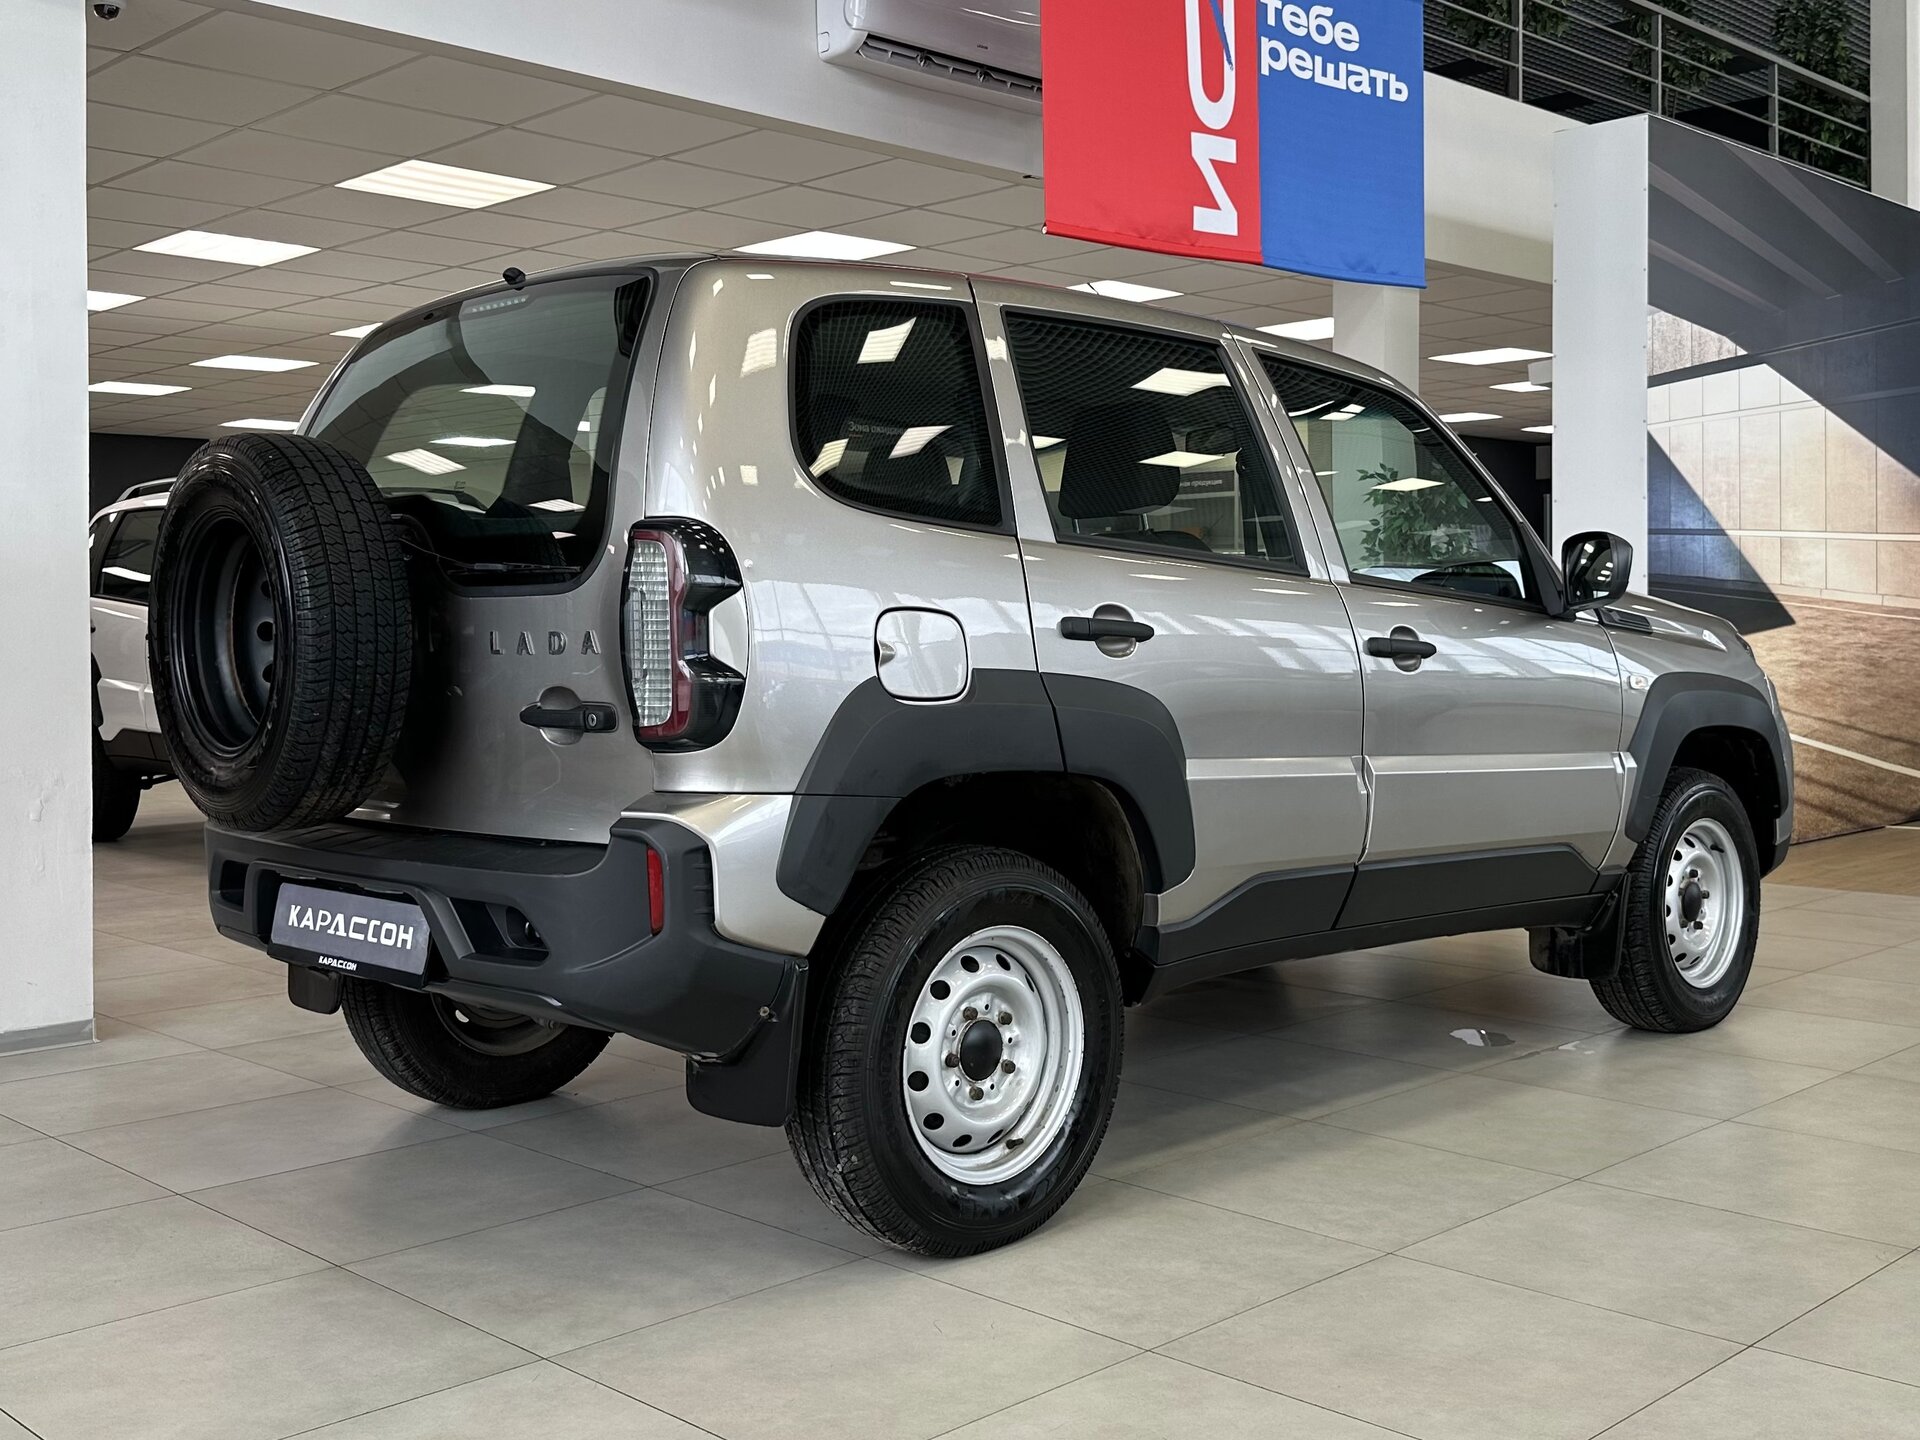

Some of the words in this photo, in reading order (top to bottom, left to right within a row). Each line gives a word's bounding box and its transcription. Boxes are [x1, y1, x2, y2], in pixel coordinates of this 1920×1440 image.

[1260, 0, 1360, 52] тебе
[1260, 36, 1409, 103] решать
[489, 630, 602, 655] LADA
[288, 904, 414, 950] КАРАССОН
[318, 955, 358, 971] КАРАССОН
